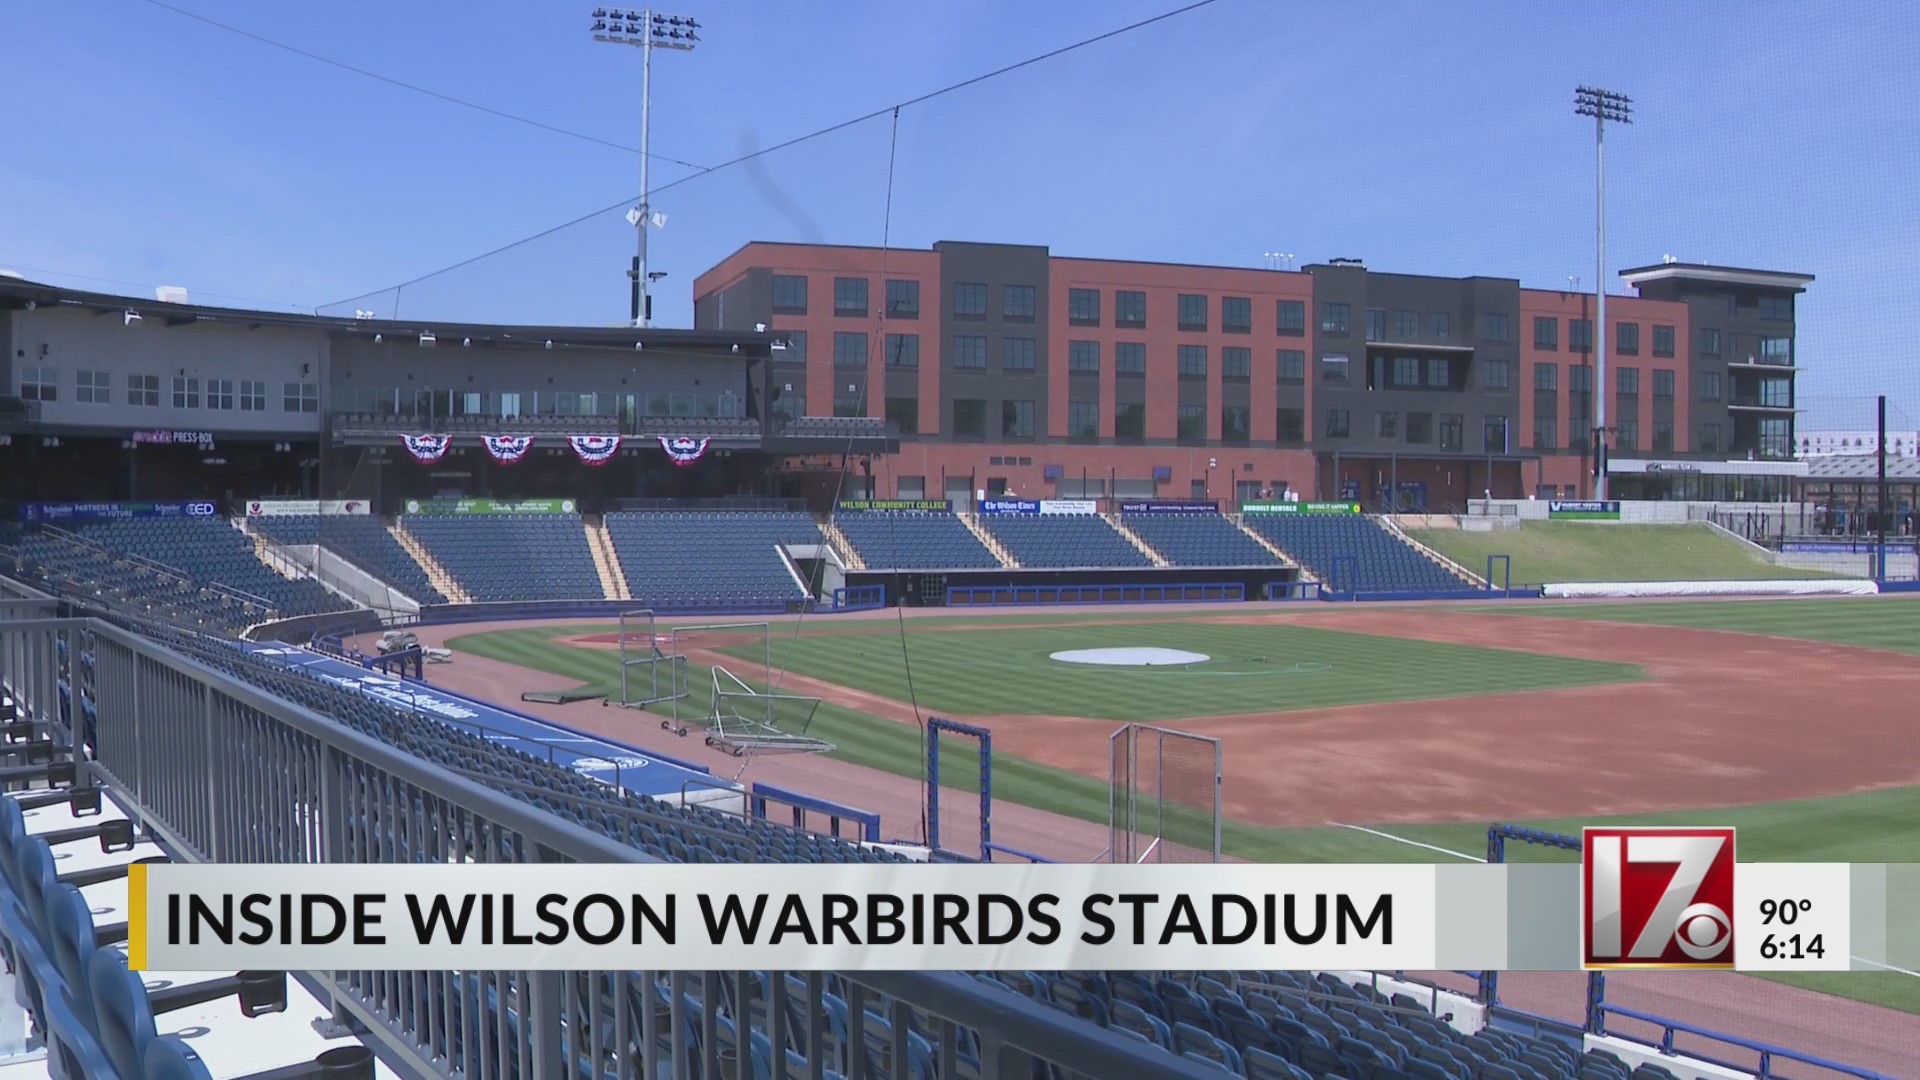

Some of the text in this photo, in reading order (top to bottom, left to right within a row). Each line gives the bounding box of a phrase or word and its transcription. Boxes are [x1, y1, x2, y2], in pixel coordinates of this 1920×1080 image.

[173, 431, 197, 443] PRESS
[75, 503, 110, 512] PARTNERS
[110, 503, 119, 512] IN
[839, 501, 947, 509] WILSON COMMUNITY COLLEGE
[984, 501, 1036, 510] The Wilson Times
